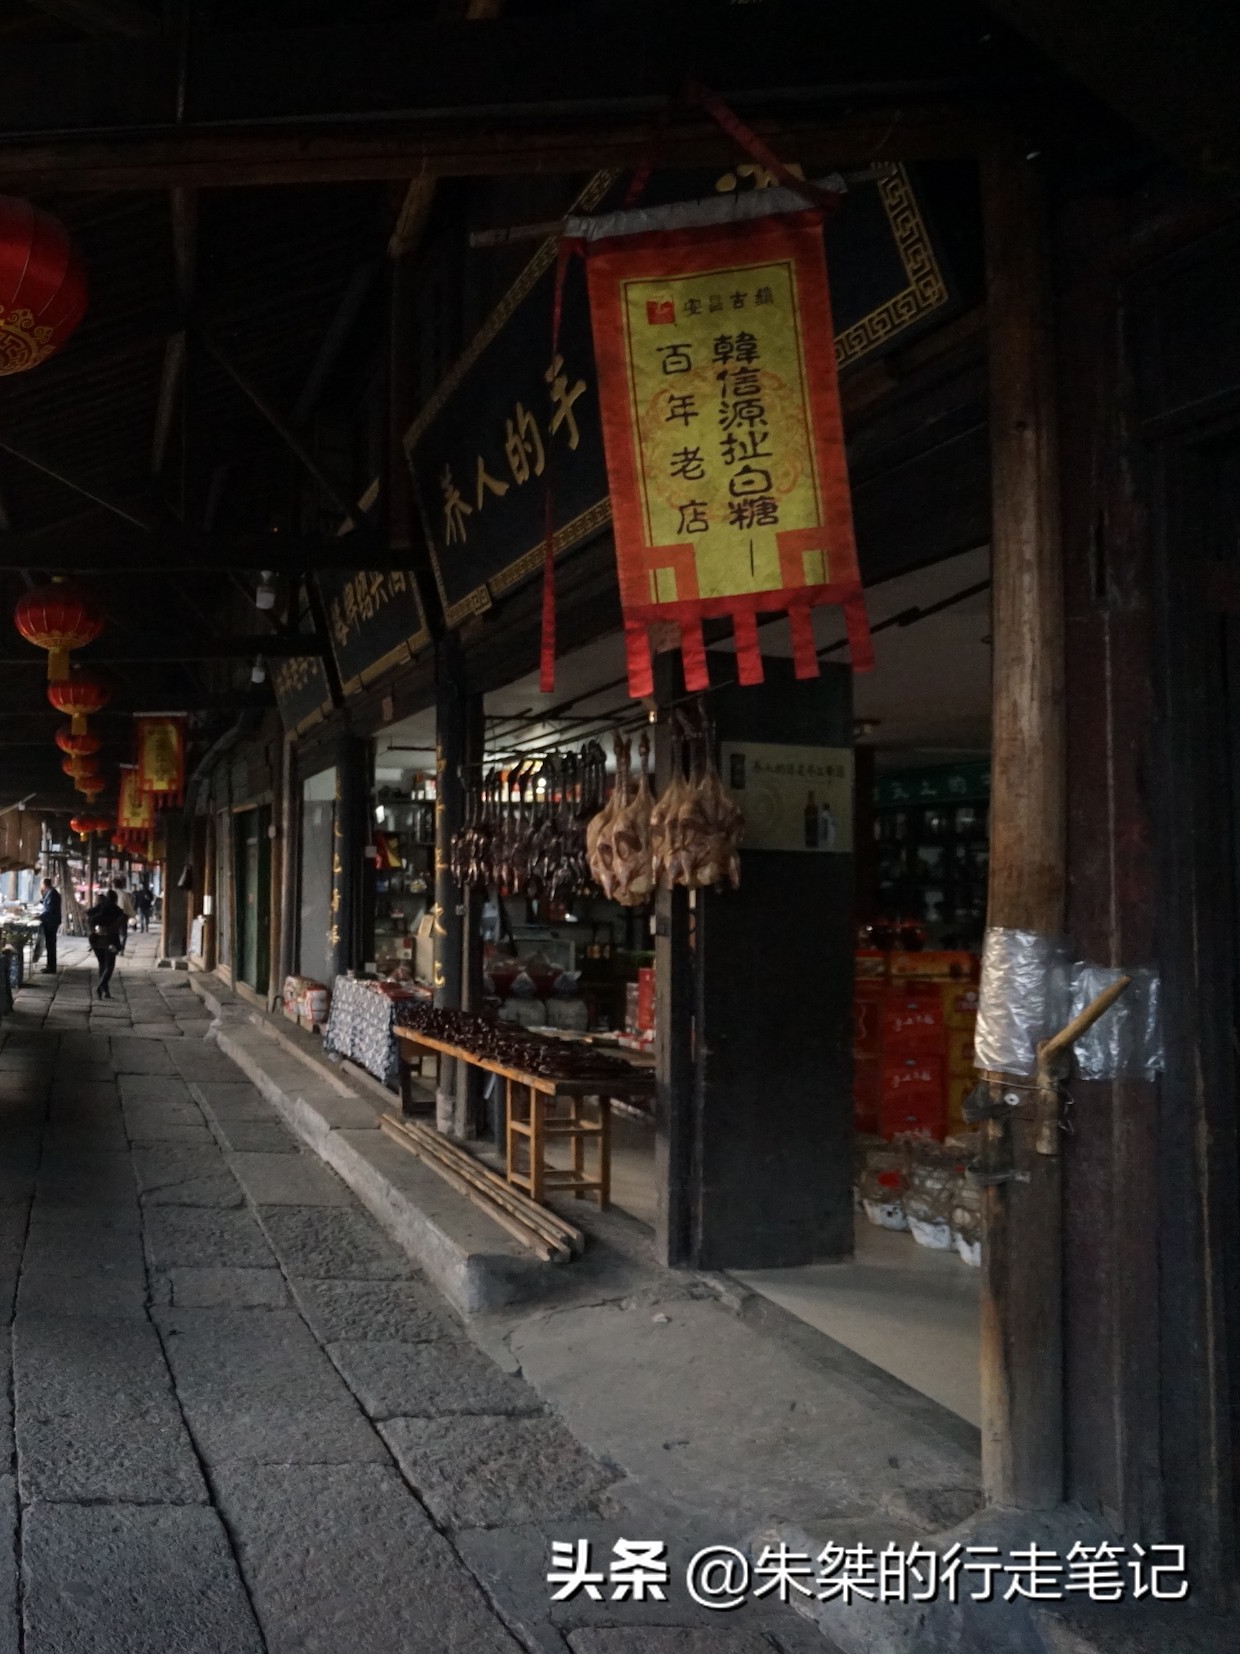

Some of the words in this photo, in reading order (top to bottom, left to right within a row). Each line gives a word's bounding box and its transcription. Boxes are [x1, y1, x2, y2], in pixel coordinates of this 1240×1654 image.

[656, 343, 709, 534] 百年老店
[712, 331, 778, 530] 韓信源扯白糖
